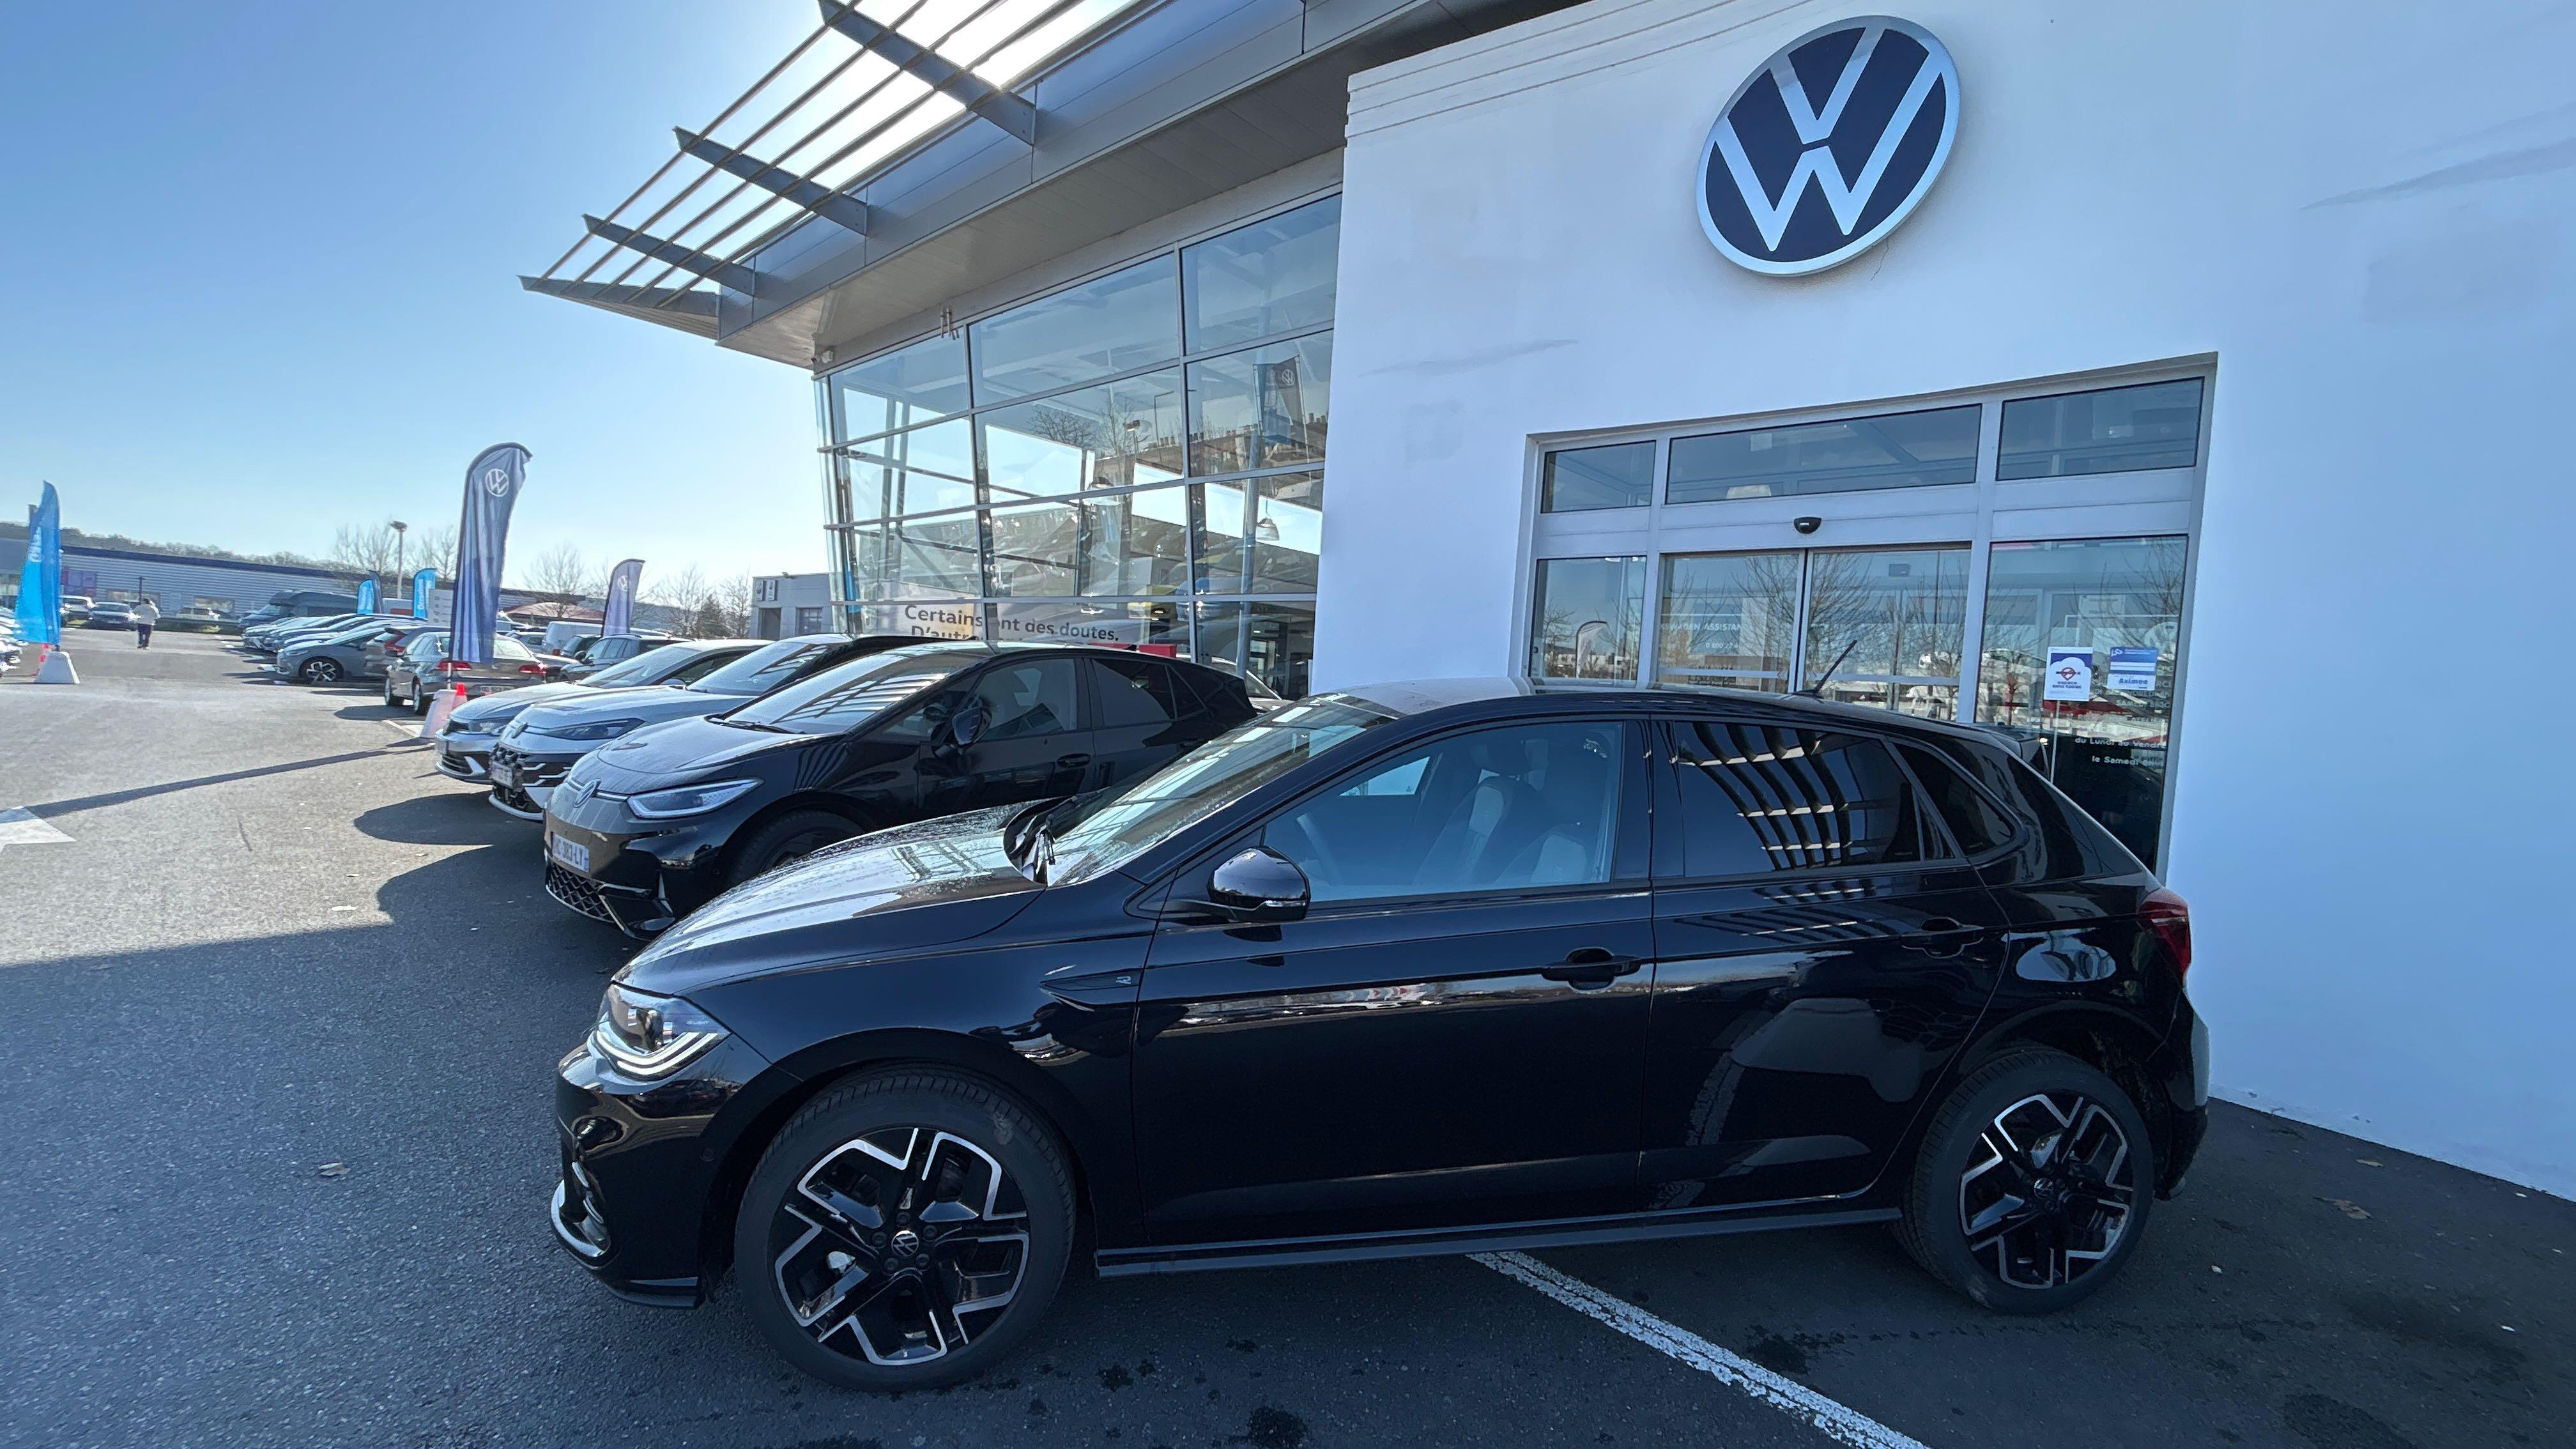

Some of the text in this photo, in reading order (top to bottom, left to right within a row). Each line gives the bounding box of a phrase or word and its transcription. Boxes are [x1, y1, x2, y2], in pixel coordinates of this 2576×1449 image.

[1701, 19, 1955, 268] VW
[486, 468, 509, 497] VW
[905, 604, 983, 627] Certains
[1025, 619, 1054, 634] des
[1059, 622, 1119, 641] doutes.
